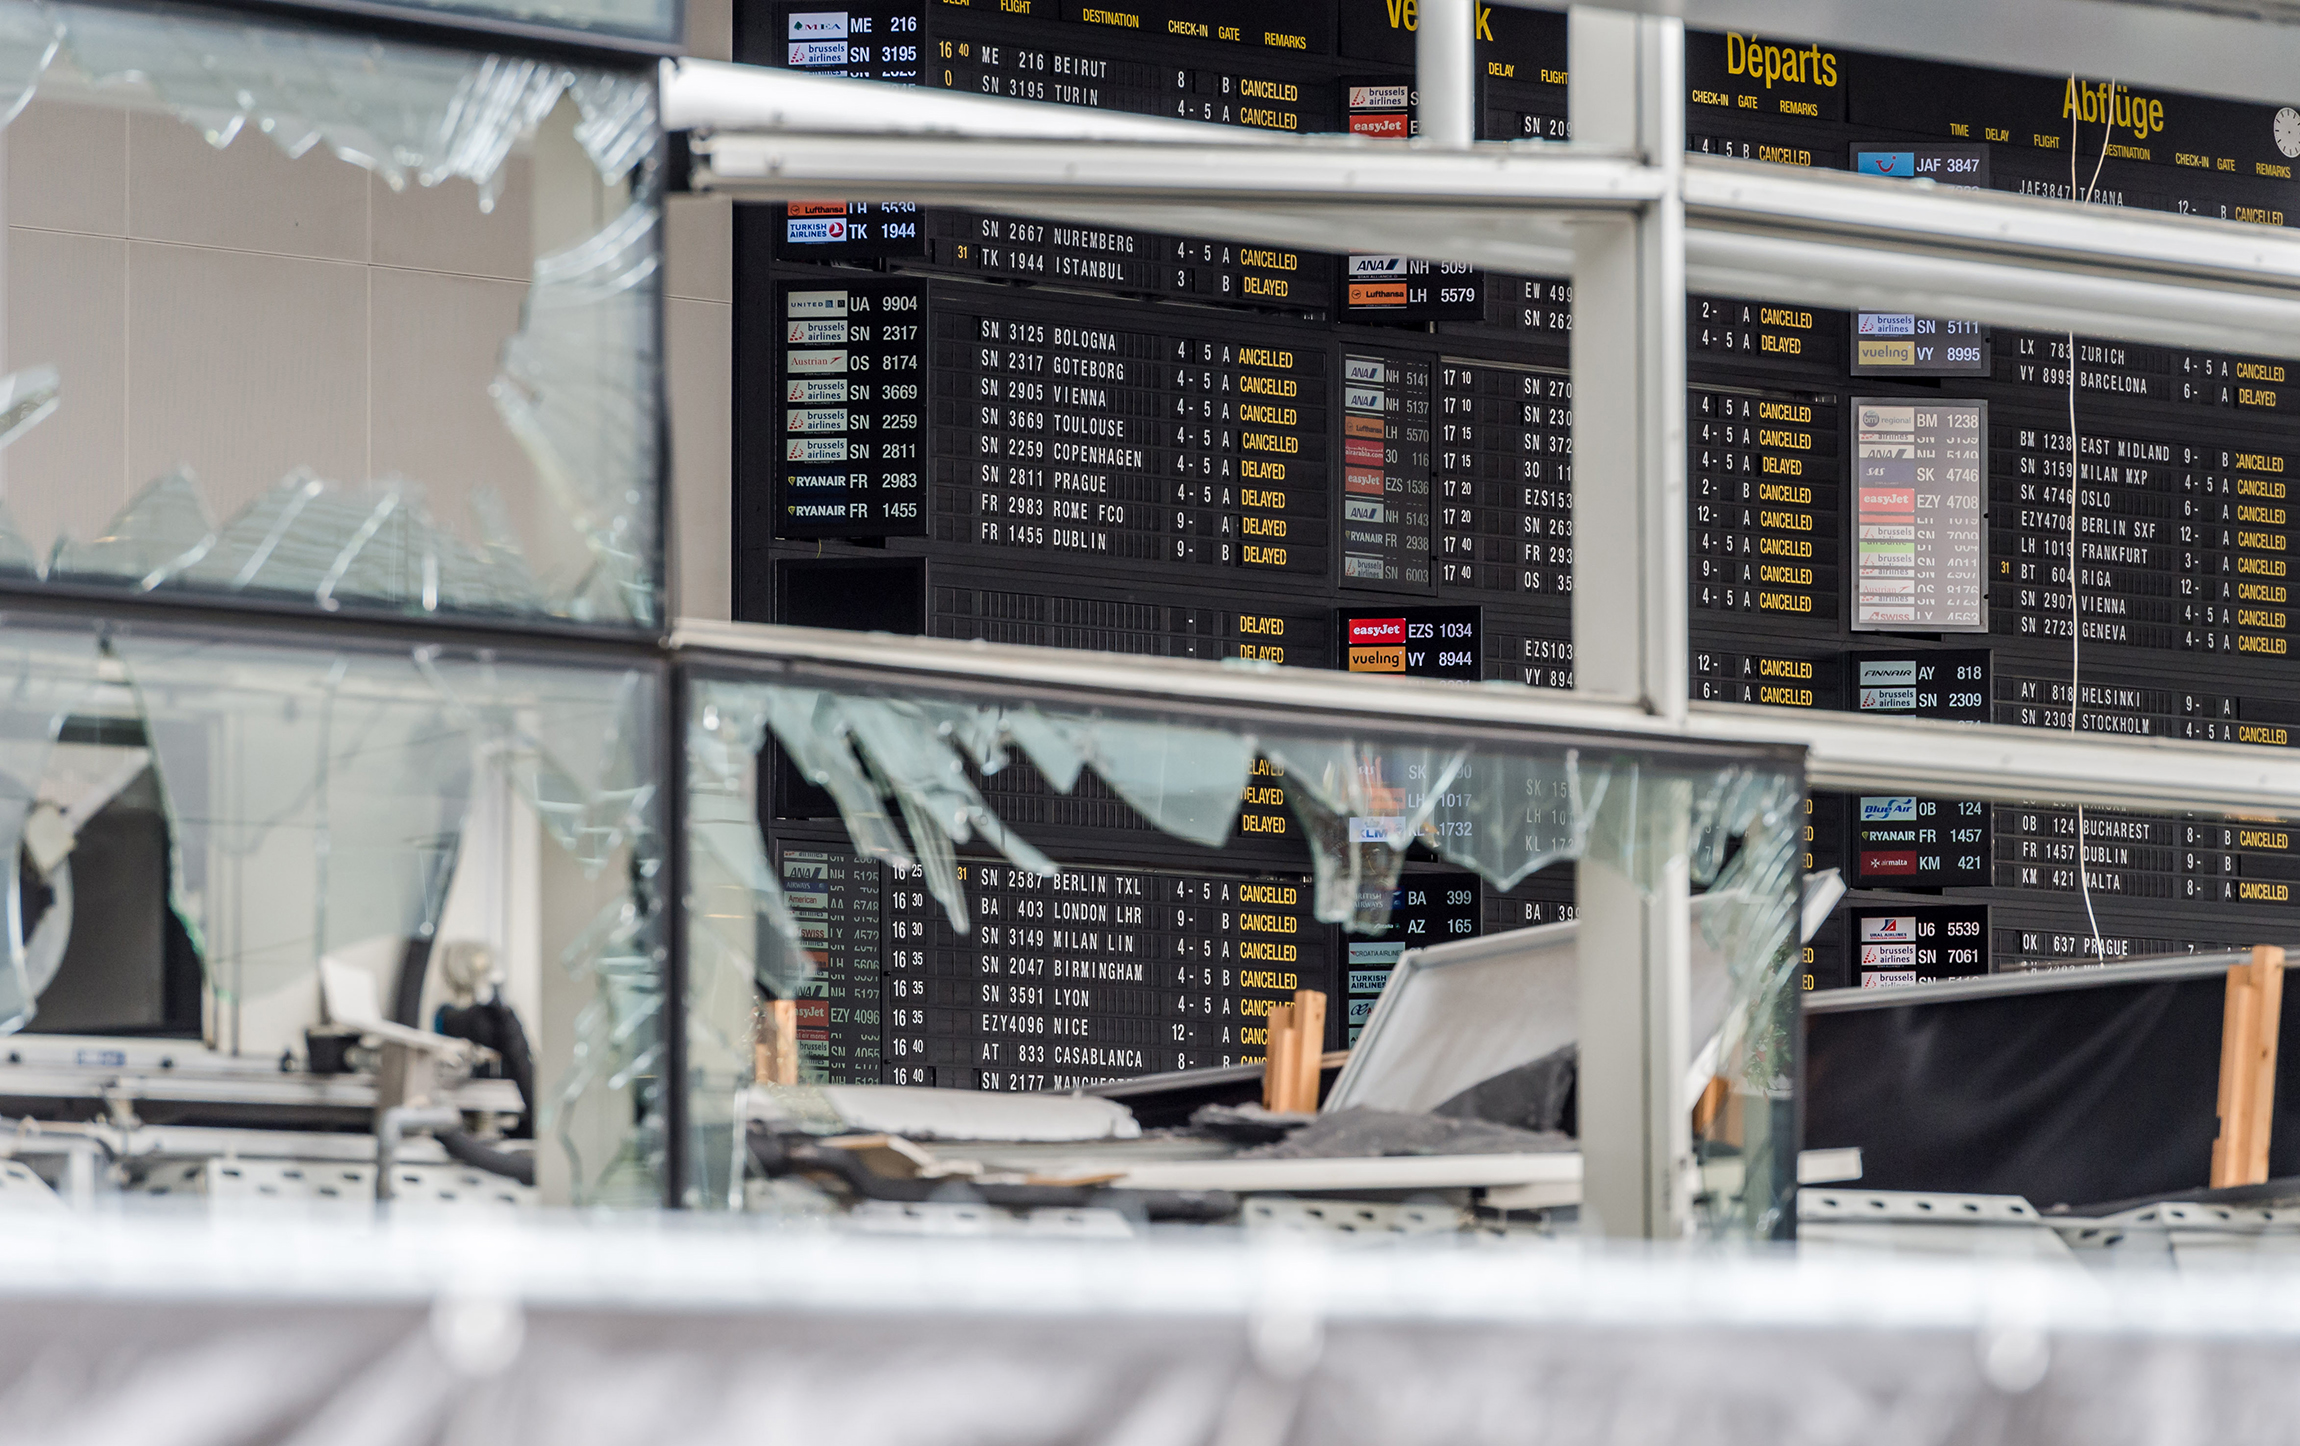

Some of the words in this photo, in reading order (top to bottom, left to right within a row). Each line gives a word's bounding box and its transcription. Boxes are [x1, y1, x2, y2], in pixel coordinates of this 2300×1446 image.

[851, 18, 872, 33] ME
[891, 17, 916, 32] 216
[1083, 9, 1139, 28] DESTINATION
[1169, 20, 1208, 37] CHECK-IN
[1219, 26, 1240, 41] GATE
[1265, 32, 1306, 49] REMARKS
[808, 44, 845, 54] brussels
[808, 53, 842, 63] airlines
[850, 47, 869, 62] SN
[882, 46, 916, 62] 3195
[1726, 31, 1838, 89] Départs
[940, 41, 952, 58] 16
[959, 43, 969, 57] 40
[982, 46, 998, 64] ME
[1019, 52, 1043, 70] 216
[1055, 56, 1106, 78] BEIRUT
[1241, 79, 1297, 101] CANCELLED
[1489, 62, 1514, 77] DELAY
[1541, 69, 1568, 85] FLIGHT
[983, 75, 998, 93] SN
[1010, 79, 1043, 99] 3195
[1055, 85, 1097, 105] TURIN
[1241, 107, 1297, 129] CANCELLED
[1693, 90, 1728, 106] CHECK-IN
[1738, 95, 1758, 109] GATE
[1780, 100, 1818, 116] REMARKS
[2062, 77, 2165, 139] Abflüge
[1354, 120, 1402, 132] easyJet
[1759, 145, 1811, 167] CANCELLED
[1950, 123, 1969, 136] TIME
[1986, 128, 2009, 141] DELAY
[2034, 134, 2059, 148] FLIGHT
[2176, 153, 2209, 167] CHECK-IN
[2217, 158, 2235, 171] GATE
[2256, 163, 2291, 178] REMARKS
[1917, 159, 1941, 171] JAF
[1947, 159, 1979, 172] 3847
[2235, 206, 2284, 226] CANCELLED
[790, 223, 827, 231] TURKISH
[790, 230, 827, 239] AIRLINES
[849, 224, 867, 239] TK
[882, 223, 915, 238] 1944
[983, 220, 998, 237] SN
[1010, 223, 1043, 242] 2667
[1054, 228, 1133, 252] NUREMBERG
[1241, 249, 1297, 270] CANCELLED
[958, 245, 967, 258] 31
[983, 249, 998, 266] TK
[1010, 252, 1043, 271] 1944
[1057, 257, 1123, 280] ISTANBUL
[1245, 277, 1288, 296] DELAYED
[851, 297, 870, 311] UA
[883, 296, 917, 311] 9904
[1410, 289, 1426, 302] LH
[1441, 288, 1474, 302] 5579
[851, 326, 869, 341] SN
[883, 326, 917, 340] 2317
[983, 321, 998, 338] SN
[1010, 324, 1043, 342] 3125
[1055, 328, 1115, 350] BOLOGNA
[1862, 345, 1909, 361] vueling
[1917, 347, 1933, 360] VY
[1948, 348, 1980, 361] 8995
[982, 349, 998, 367] SN
[1009, 352, 1043, 371] 2317
[1054, 357, 1123, 380] GOTEBORG
[1240, 376, 1296, 397] CANCELLED
[2082, 346, 2124, 364] ZURICH
[2237, 363, 2284, 382] CANCELLED
[850, 385, 869, 400] SN
[882, 385, 917, 399] 3669
[2081, 372, 2146, 393] BARCELONA
[2239, 388, 2276, 406] DELAYED
[1760, 402, 1811, 422] CANCELLED
[982, 407, 998, 425] SN
[1010, 410, 1043, 429] 3669
[1054, 415, 1123, 437] TOULOUSE
[1243, 433, 1298, 453] CANCELLED
[982, 436, 997, 453] SN
[1009, 439, 1042, 457] 2259
[1054, 443, 1141, 467] COPENHAGEN
[1242, 461, 1285, 480] DELAYED
[2082, 437, 2109, 455] EAST
[2118, 441, 2169, 461] MIDLAND
[1763, 457, 1802, 475] DELAYED
[797, 506, 845, 516] RYANAIR
[850, 504, 867, 518] FR
[883, 503, 916, 517] 1455
[2082, 517, 2125, 535] BERLIN
[2135, 522, 2155, 538] SXF
[2238, 532, 2286, 550] CANCELLED
[982, 523, 997, 540] FR
[1010, 525, 1042, 544] 1455
[1054, 529, 1105, 549] DUBLIN
[1244, 546, 1286, 565] DELAYED
[2082, 543, 2147, 563] FRANKFURT
[2238, 558, 2286, 576] CANCELLED
[2082, 570, 2111, 587] RIGA
[1240, 616, 1283, 635] DELAYED
[1354, 625, 1400, 636] easyJet
[1409, 624, 1433, 638] EZS
[1440, 623, 1472, 637] 1034
[2083, 622, 2126, 640] GENEVA
[2239, 635, 2286, 654] CANCELLED
[1352, 651, 1400, 668] vueling
[1408, 652, 1425, 666] VY
[1439, 652, 1472, 666] 8944
[1864, 669, 1912, 678] FINNAIR
[1919, 667, 1935, 680] AY
[1957, 666, 1981, 679] 818
[1919, 694, 1937, 707] SN
[1949, 693, 1981, 707] 2309
[2082, 687, 2139, 707] HELSINKI
[2083, 714, 2149, 733] STOCKHOLM
[2239, 726, 2287, 744] CANCELLED
[1920, 829, 1936, 842] FR
[1950, 829, 1982, 842] 1457
[2083, 820, 2150, 840] BUCHAREST
[2240, 831, 2288, 848] CANCELLED
[1920, 856, 1939, 869] KM
[1958, 856, 1980, 869] 421
[1053, 874, 1106, 894] BERLIN
[1116, 877, 1141, 895] TXL
[1240, 885, 1296, 904] CANCELLED
[1409, 891, 1426, 905] BA
[1447, 891, 1471, 904] 399
[893, 892, 906, 909] 16
[912, 893, 922, 906] 30
[982, 898, 998, 914] BA
[1018, 900, 1043, 917] 403
[1055, 902, 1106, 921] LONDON
[1117, 906, 1141, 923] LHR
[1240, 914, 1296, 933] CANCELLED
[1408, 920, 1425, 933] AZ
[1448, 919, 1471, 933] 165
[1919, 923, 1935, 936] U6
[1948, 922, 1979, 936] 5539
[1054, 931, 1097, 949] MILAN
[1109, 934, 1132, 952] LIN
[1240, 942, 1296, 961] CANCELLED
[1055, 960, 1142, 981] BIRMINGHAM
[1241, 970, 1297, 989] CANCELLED
[1056, 989, 1088, 1006] LYON
[983, 1014, 1043, 1033] EZY4096
[1054, 1018, 1088, 1035] NICE
[1019, 1045, 1043, 1062] 833
[1055, 1046, 1142, 1067] CASABLANCA
